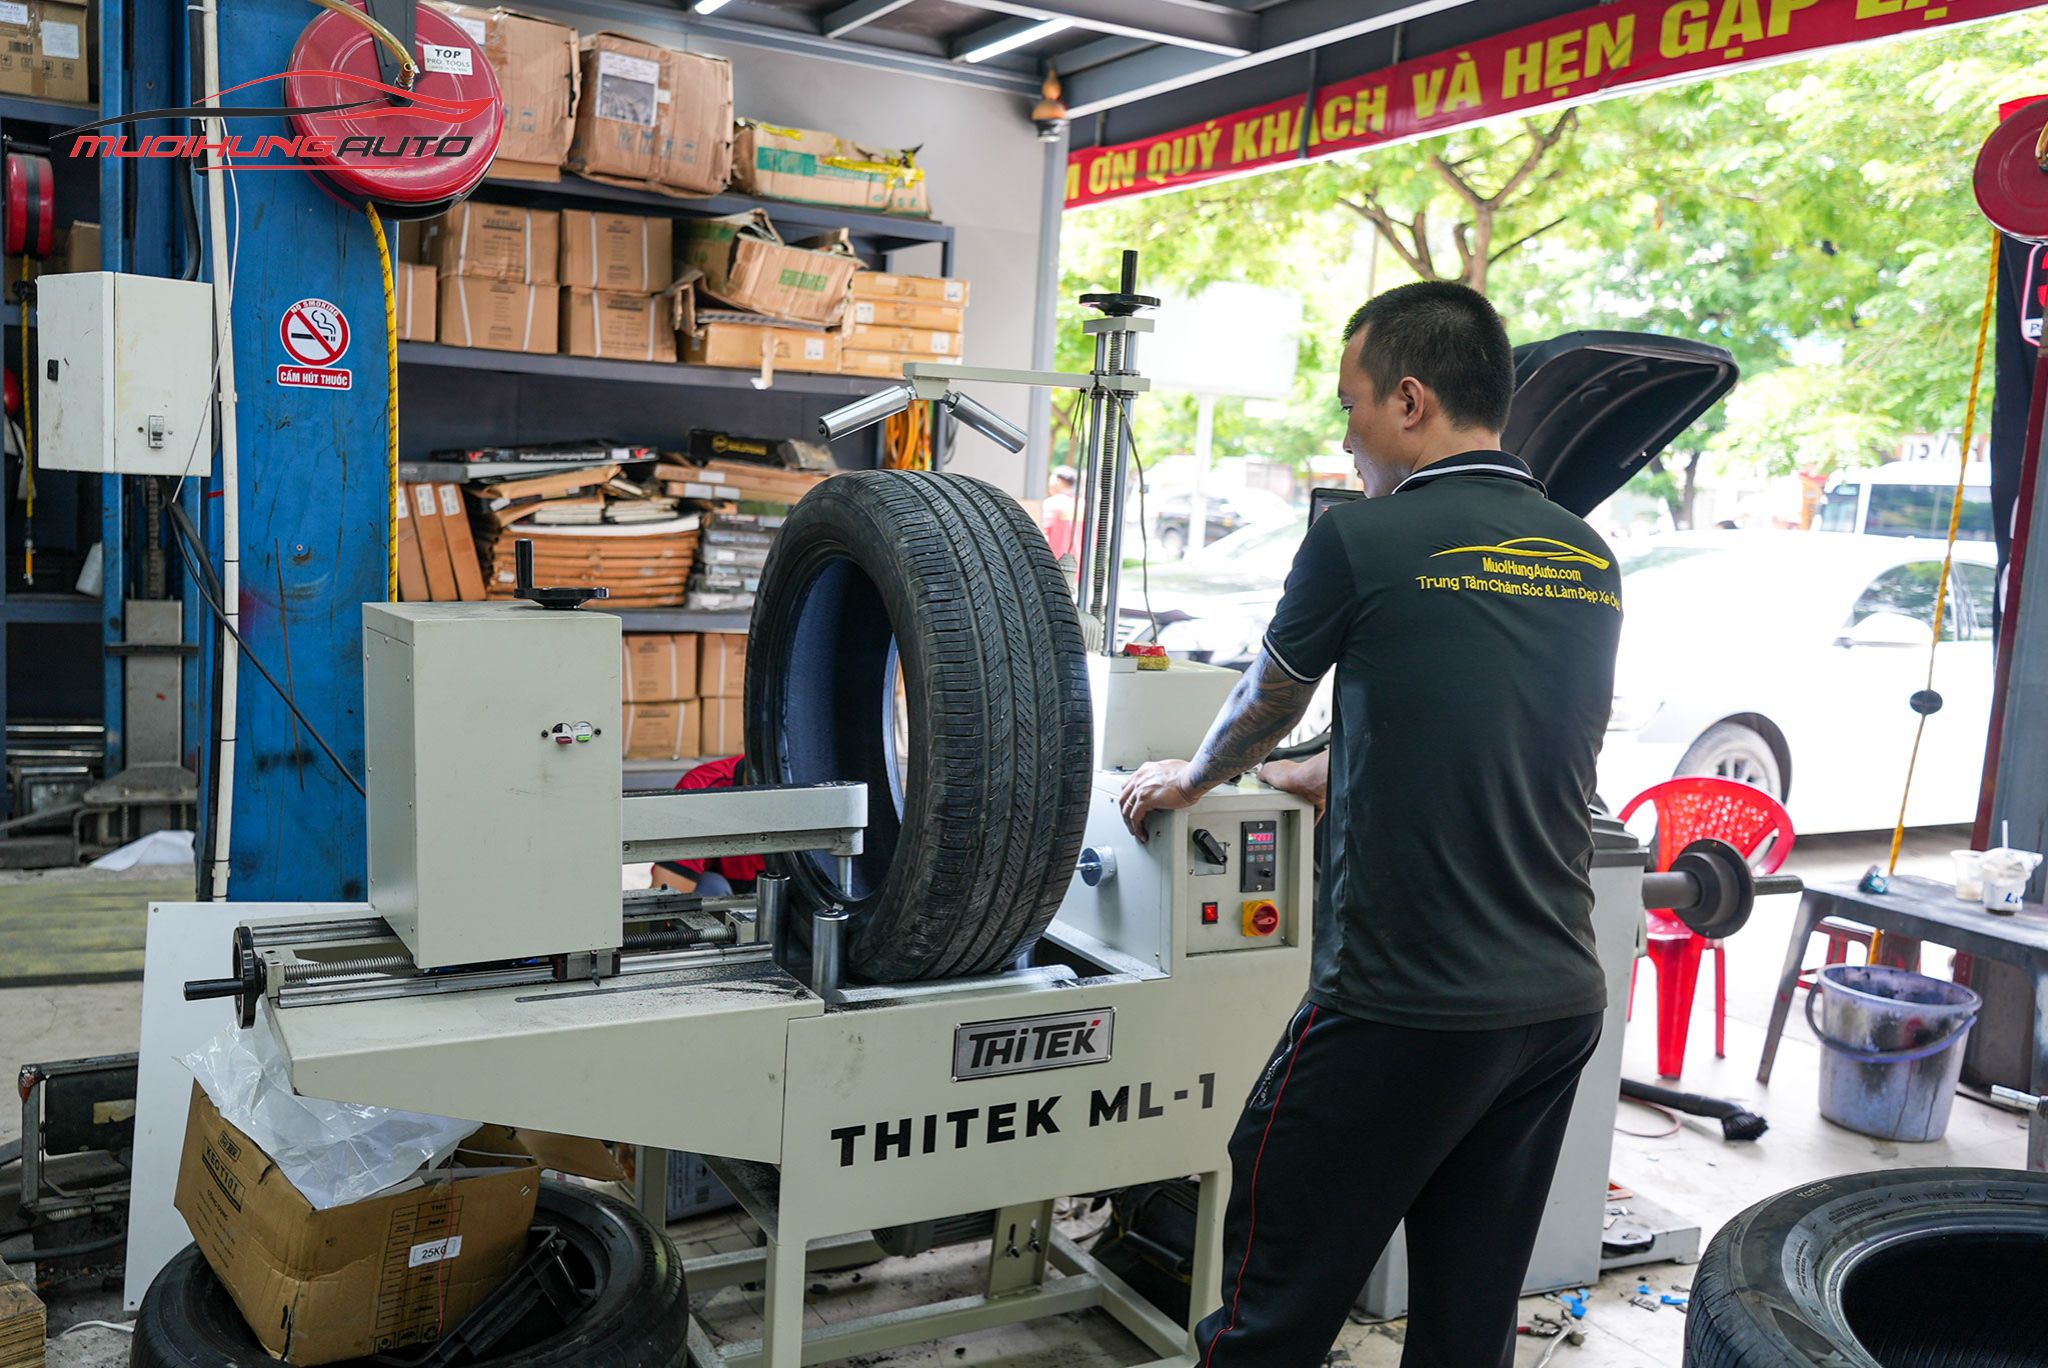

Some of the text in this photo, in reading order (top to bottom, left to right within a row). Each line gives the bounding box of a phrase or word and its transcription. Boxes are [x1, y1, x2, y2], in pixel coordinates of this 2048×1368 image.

[434, 48, 461, 59] TOP
[1147, 120, 1222, 185] QUÝ
[1412, 52, 1482, 120] VÀ
[1501, 14, 1636, 98] HẸN
[291, 300, 340, 318] NO SMOKING
[302, 370, 320, 384] HÚT
[1416, 576, 1460, 591] Trung
[1461, 575, 1488, 591] Tâm
[1522, 582, 1544, 597] Sóc
[1544, 584, 1554, 598] &
[1554, 584, 1579, 600] Làm
[1578, 587, 1599, 603] Đẹp
[1598, 590, 1610, 605] Xe
[831, 1072, 1216, 1168] THITEK ML-1
